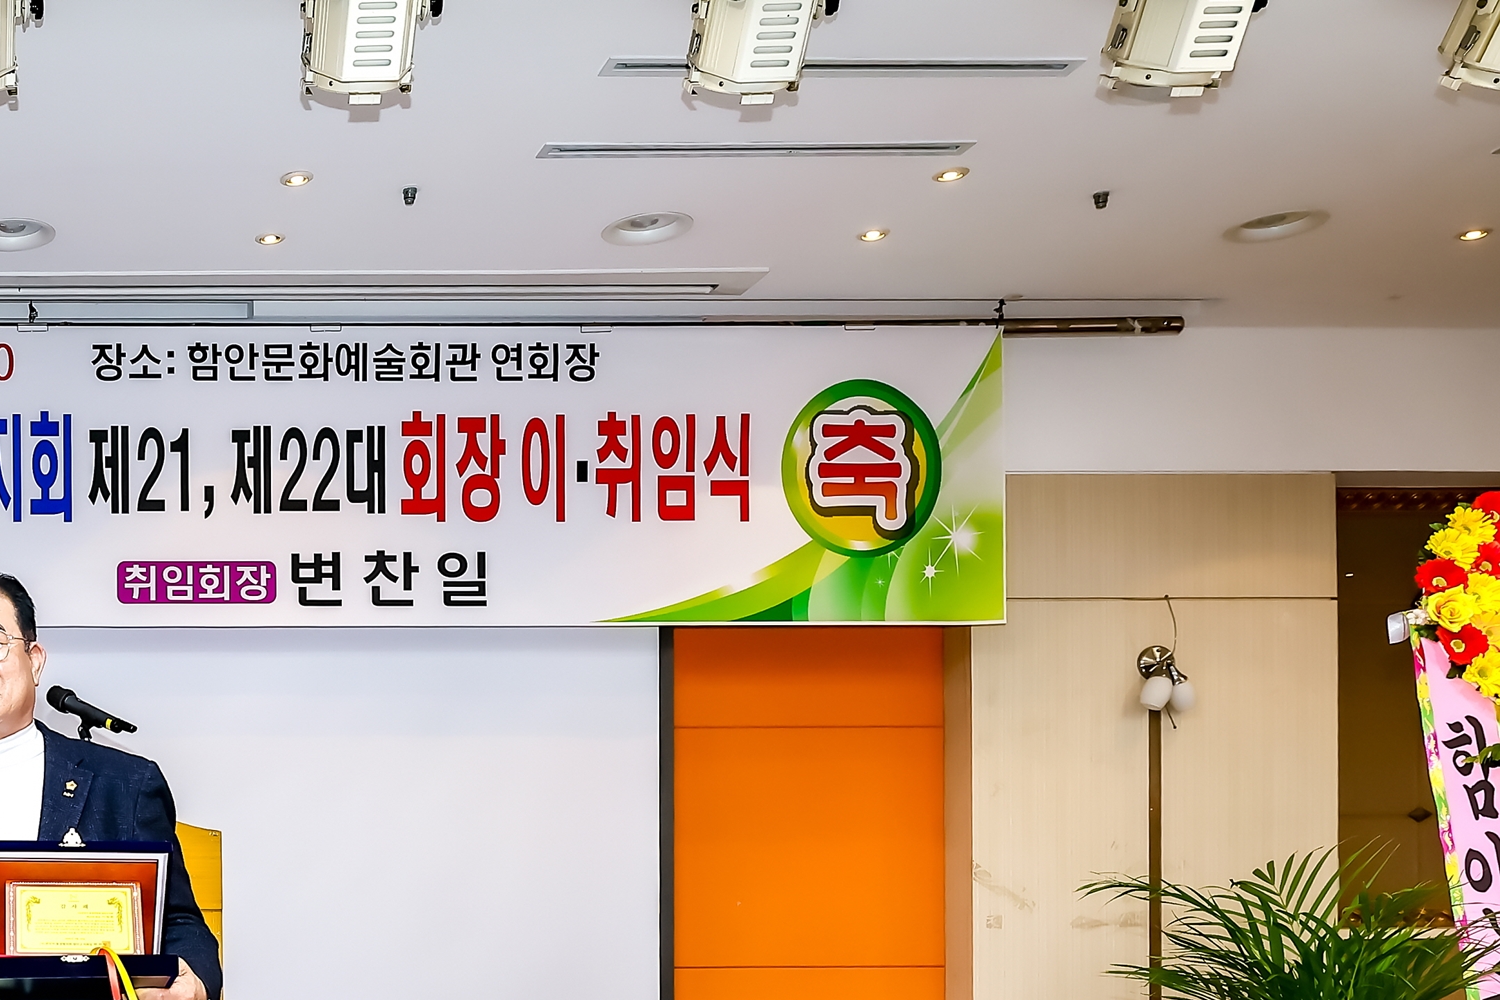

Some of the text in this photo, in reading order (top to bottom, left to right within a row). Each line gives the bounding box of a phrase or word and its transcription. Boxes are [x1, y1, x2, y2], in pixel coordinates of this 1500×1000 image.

[92, 342, 599, 382] 장소: 함안문화예술회관 연회장
[88, 426, 214, 519] 제21,
[231, 426, 385, 514] 제22대
[401, 411, 506, 522] 회장
[815, 414, 906, 524] 축
[124, 564, 271, 601] 취임회장
